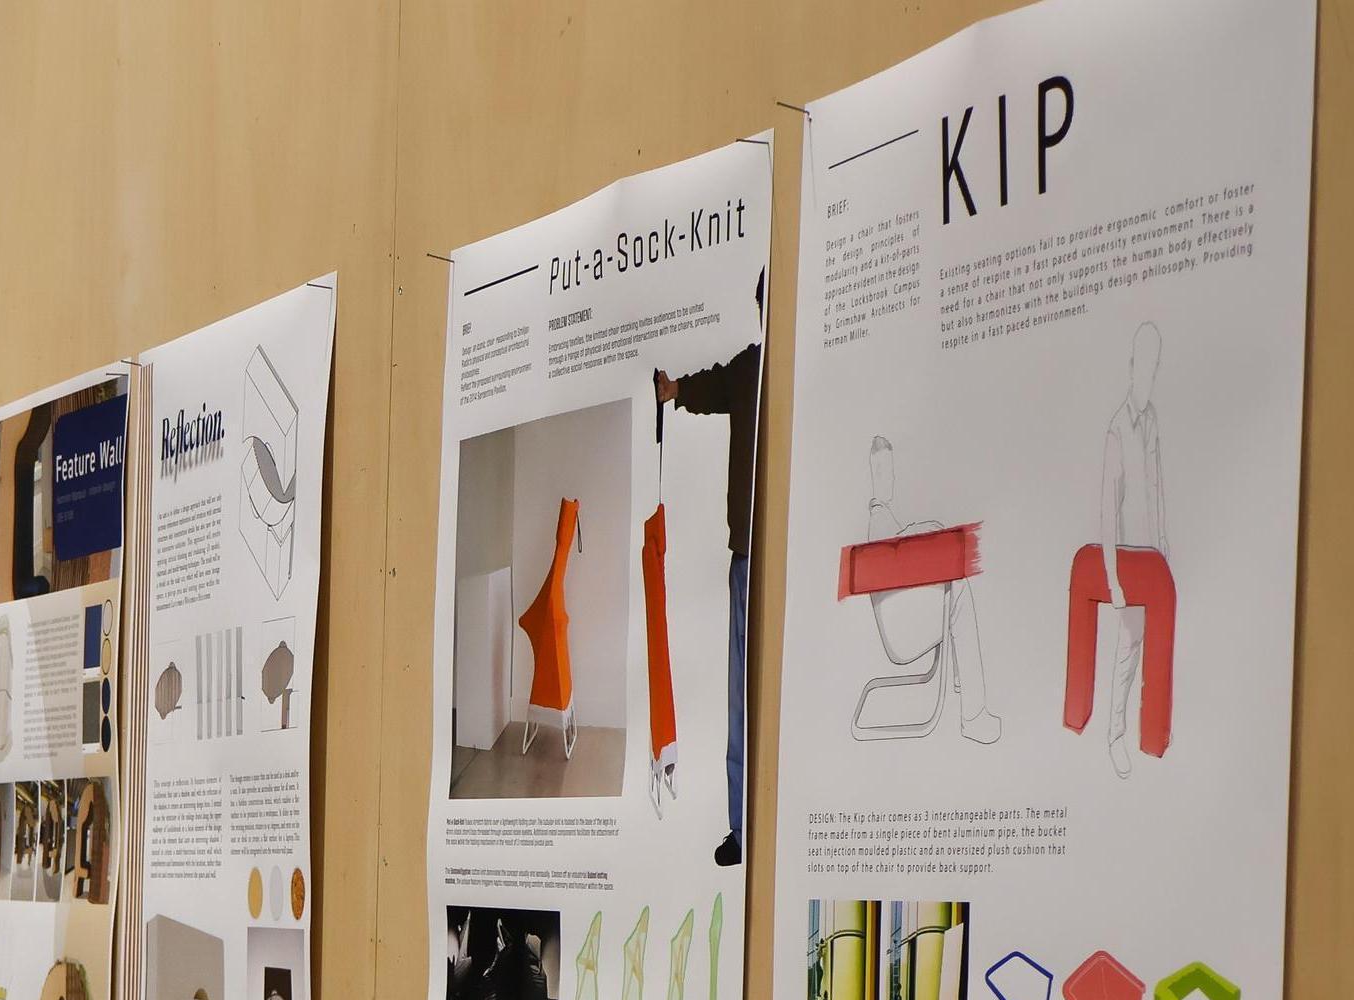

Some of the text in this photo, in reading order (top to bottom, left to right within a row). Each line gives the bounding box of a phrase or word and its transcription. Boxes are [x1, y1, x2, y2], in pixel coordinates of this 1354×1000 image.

[942, 75, 1075, 225] KIP
[827, 199, 848, 218] BRIEF:
[550, 198, 745, 295] Put-a-Sock-Knit
[825, 224, 919, 267] the design principles of
[826, 211, 919, 251] Design a chair that fosters
[939, 184, 1254, 280] Existing seating options fail to provide ergonomic comfort or foster
[940, 288, 944, 297] a
[947, 281, 968, 295] sense
[971, 274, 979, 288] of
[982, 270, 1010, 285] respite
[1013, 267, 1021, 276] in
[1025, 264, 1029, 274] a
[1033, 258, 1048, 271] fast
[1052, 249, 1077, 268] paced
[1081, 238, 1126, 257] university
[1202, 210, 1229, 224] There
[1235, 206, 1242, 216] is
[1248, 204, 1253, 214] a
[824, 262, 919, 300] approach evident in the design
[825, 266, 858, 282] modularity
[860, 258, 872, 271] and
[874, 258, 878, 267] a
[940, 223, 1252, 314] need for a chair that not only supports the human body effectively
[941, 243, 1252, 332] but also harmonizes with the buildings design philosophy. Providing
[824, 279, 919, 316] of the Locksbrook Campus
[824, 295, 920, 334] by Grimshaw Architects for
[823, 335, 847, 348] Herman
[941, 335, 968, 349] respite
[971, 330, 978, 342] in
[981, 330, 985, 339] a
[988, 324, 1003, 336] fast
[1006, 316, 1030, 334] paced
[161, 402, 224, 464] Reflection.
[56, 436, 122, 482] Feature Wall
[808, 829, 829, 840] frame
[830, 829, 848, 839] made
[850, 828, 867, 839] from
[869, 831, 873, 839] a
[875, 828, 898, 841] single
[900, 828, 920, 840] piece
[923, 826, 931, 838] of
[933, 827, 950, 838] bent
[953, 826, 995, 837] aluminium
[1021, 826, 1035, 837] the
[1038, 825, 1065, 836] bucket
[838, 812, 850, 823] The
[853, 813, 865, 824] Kip
[867, 811, 885, 822] chair
[888, 813, 911, 822] comes
[913, 813, 922, 821] as
[924, 810, 928, 821] 3
[931, 809, 996, 823] interchangeable
[1026, 807, 1040, 819] The
[1043, 808, 1066, 818] metal
[807, 861, 824, 872] slots
[826, 864, 834, 872] on
[837, 863, 849, 874] top
[851, 860, 859, 872] of
[861, 861, 873, 872] the
[875, 861, 894, 872] chair
[896, 863, 904, 872] to
[907, 861, 936, 874] provide
[938, 861, 956, 872] back
[808, 843, 1065, 858] seat injection moulded plastic and an oversized plush cushion that
